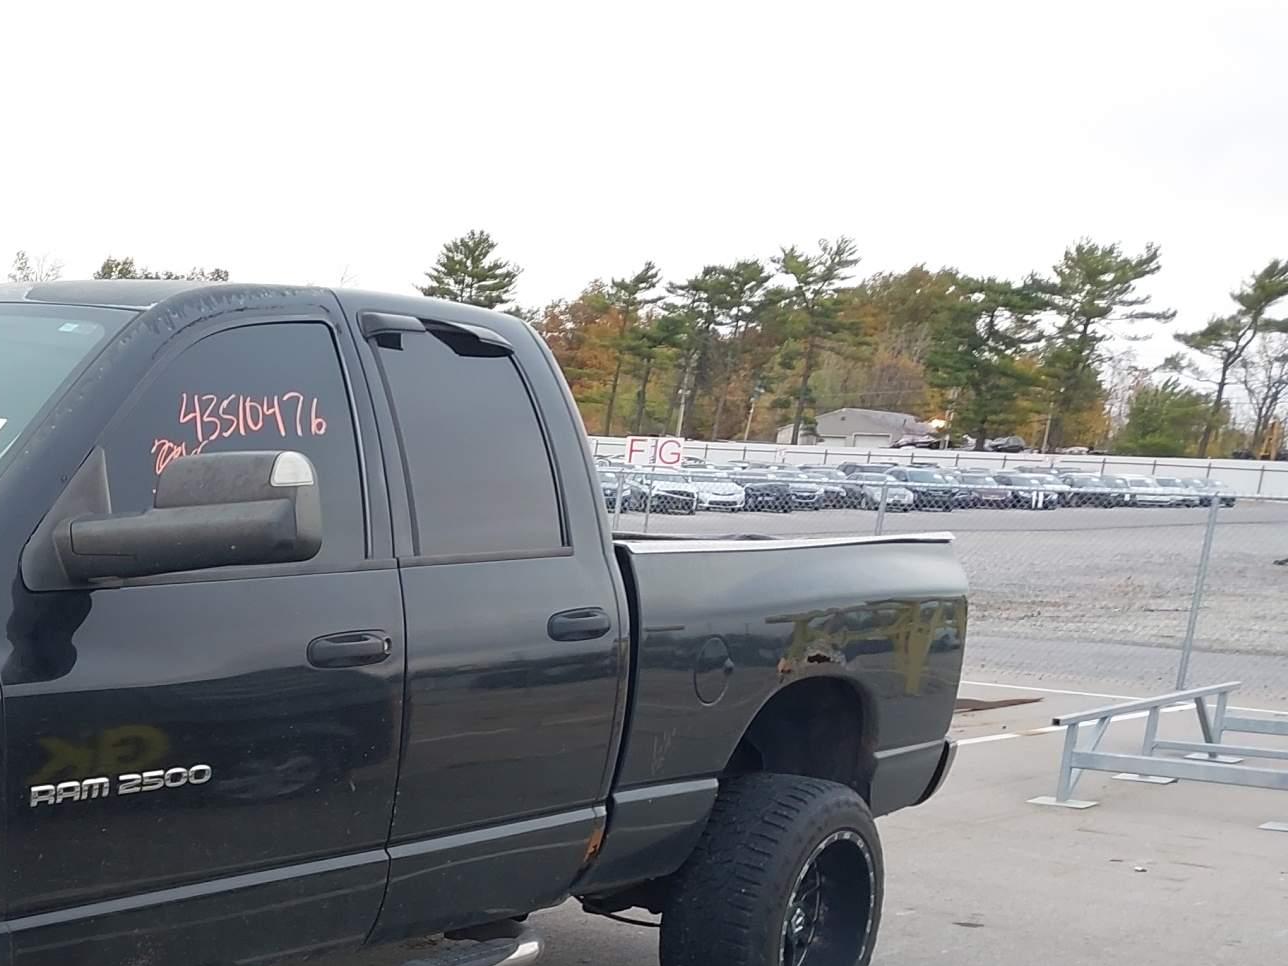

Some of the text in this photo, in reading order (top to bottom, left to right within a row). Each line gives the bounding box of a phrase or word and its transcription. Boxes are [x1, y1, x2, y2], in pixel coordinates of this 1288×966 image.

[179, 391, 328, 441] 43510476
[29, 764, 213, 808] RAM 2500
